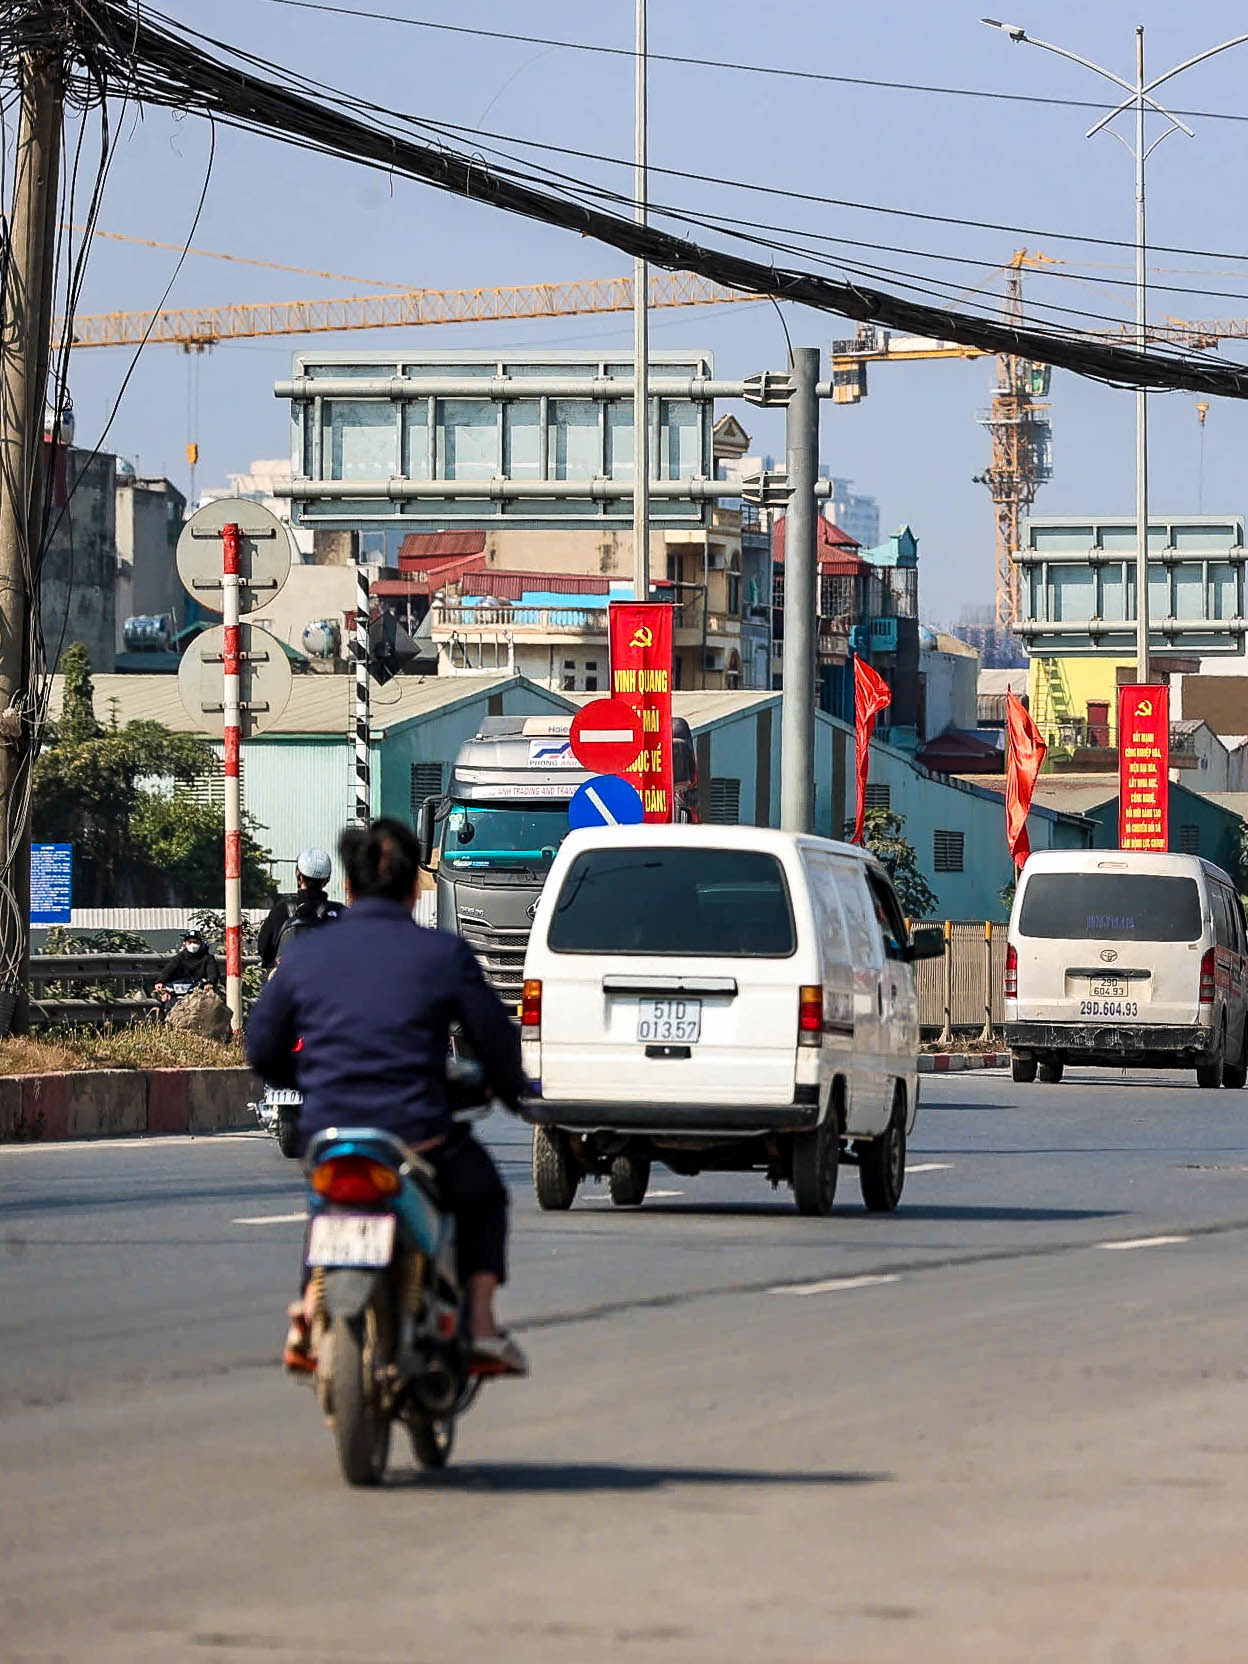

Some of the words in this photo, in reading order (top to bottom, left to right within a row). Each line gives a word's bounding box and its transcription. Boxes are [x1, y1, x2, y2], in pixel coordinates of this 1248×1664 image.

[614, 669, 636, 692] VINH
[638, 669, 668, 695] QUANG
[644, 784, 667, 813] DÂN!
[1101, 978, 1118, 988] 29D
[654, 1001, 687, 1020] 51D
[1080, 1001, 1138, 1017] 29D.604.93
